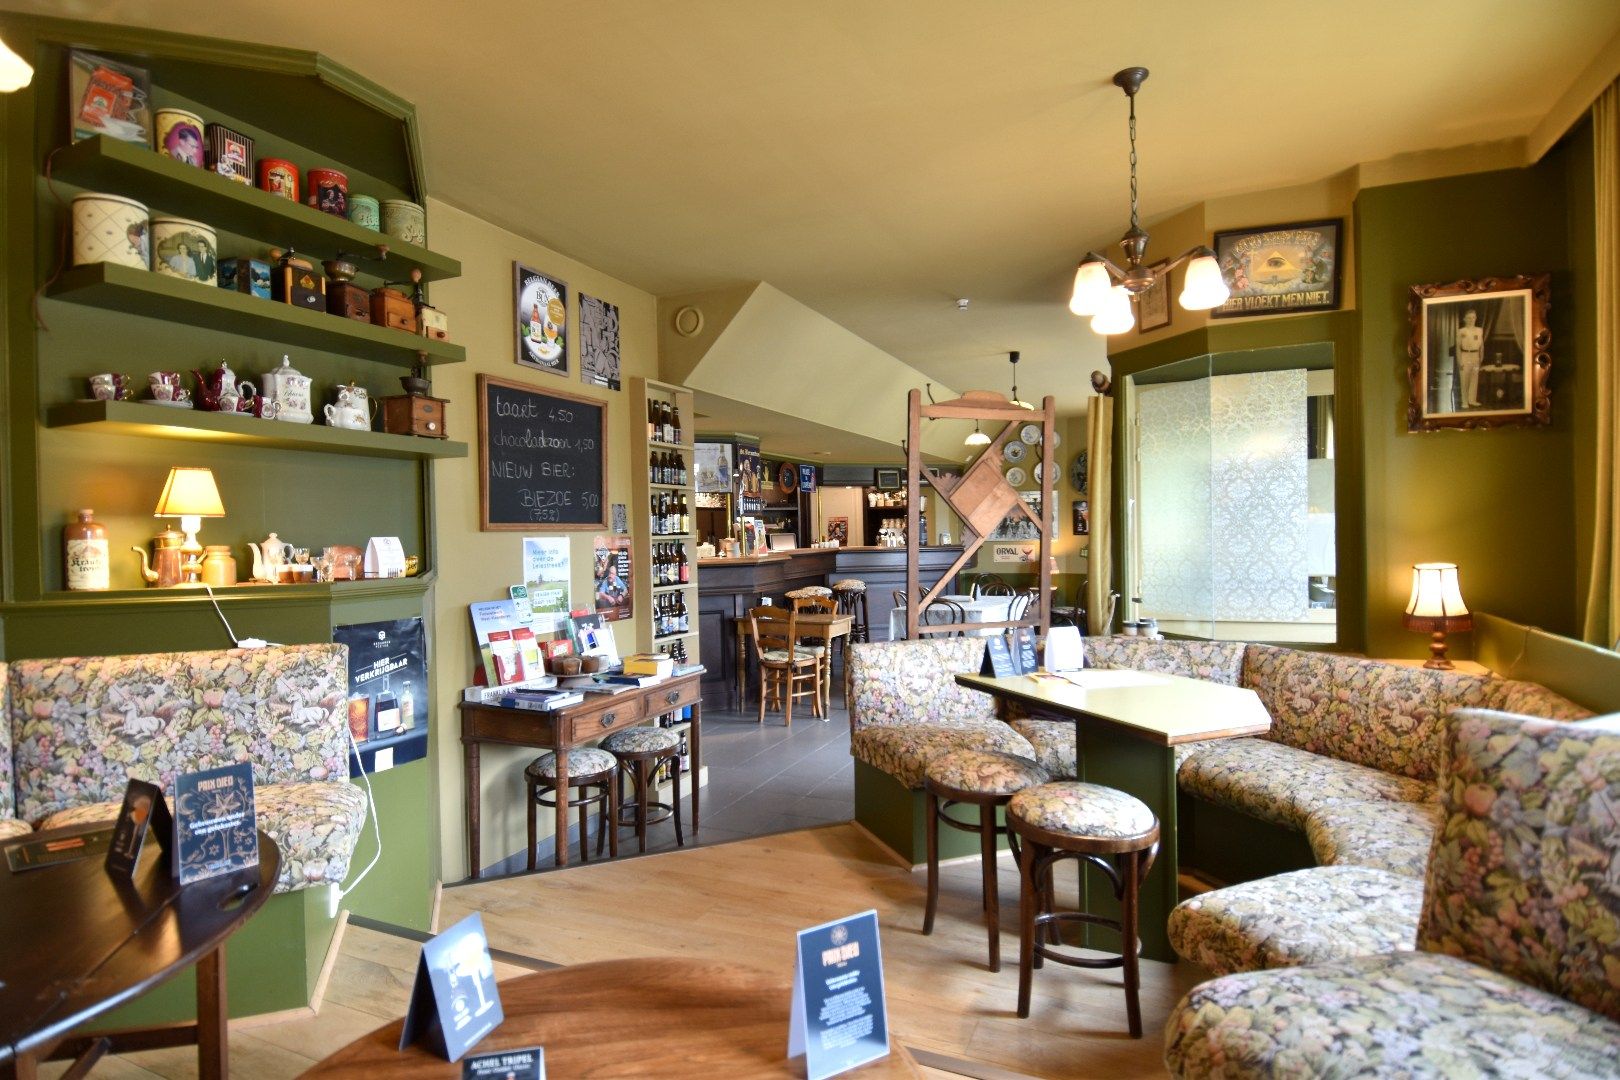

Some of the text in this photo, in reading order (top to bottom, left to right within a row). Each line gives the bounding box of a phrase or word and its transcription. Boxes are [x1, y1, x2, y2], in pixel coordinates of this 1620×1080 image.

[1222, 297, 1243, 311] HIER
[1244, 294, 1281, 308] VLOEKT
[1282, 292, 1304, 307] MEN
[496, 394, 574, 423] taart 4,50
[574, 439, 595, 453] 1,50
[491, 460, 576, 479] NIEUW BIER:
[518, 488, 599, 509] BIEZOE 5,00
[355, 657, 408, 684] VERKRIJGBAAR
[373, 656, 390, 670] HIER
